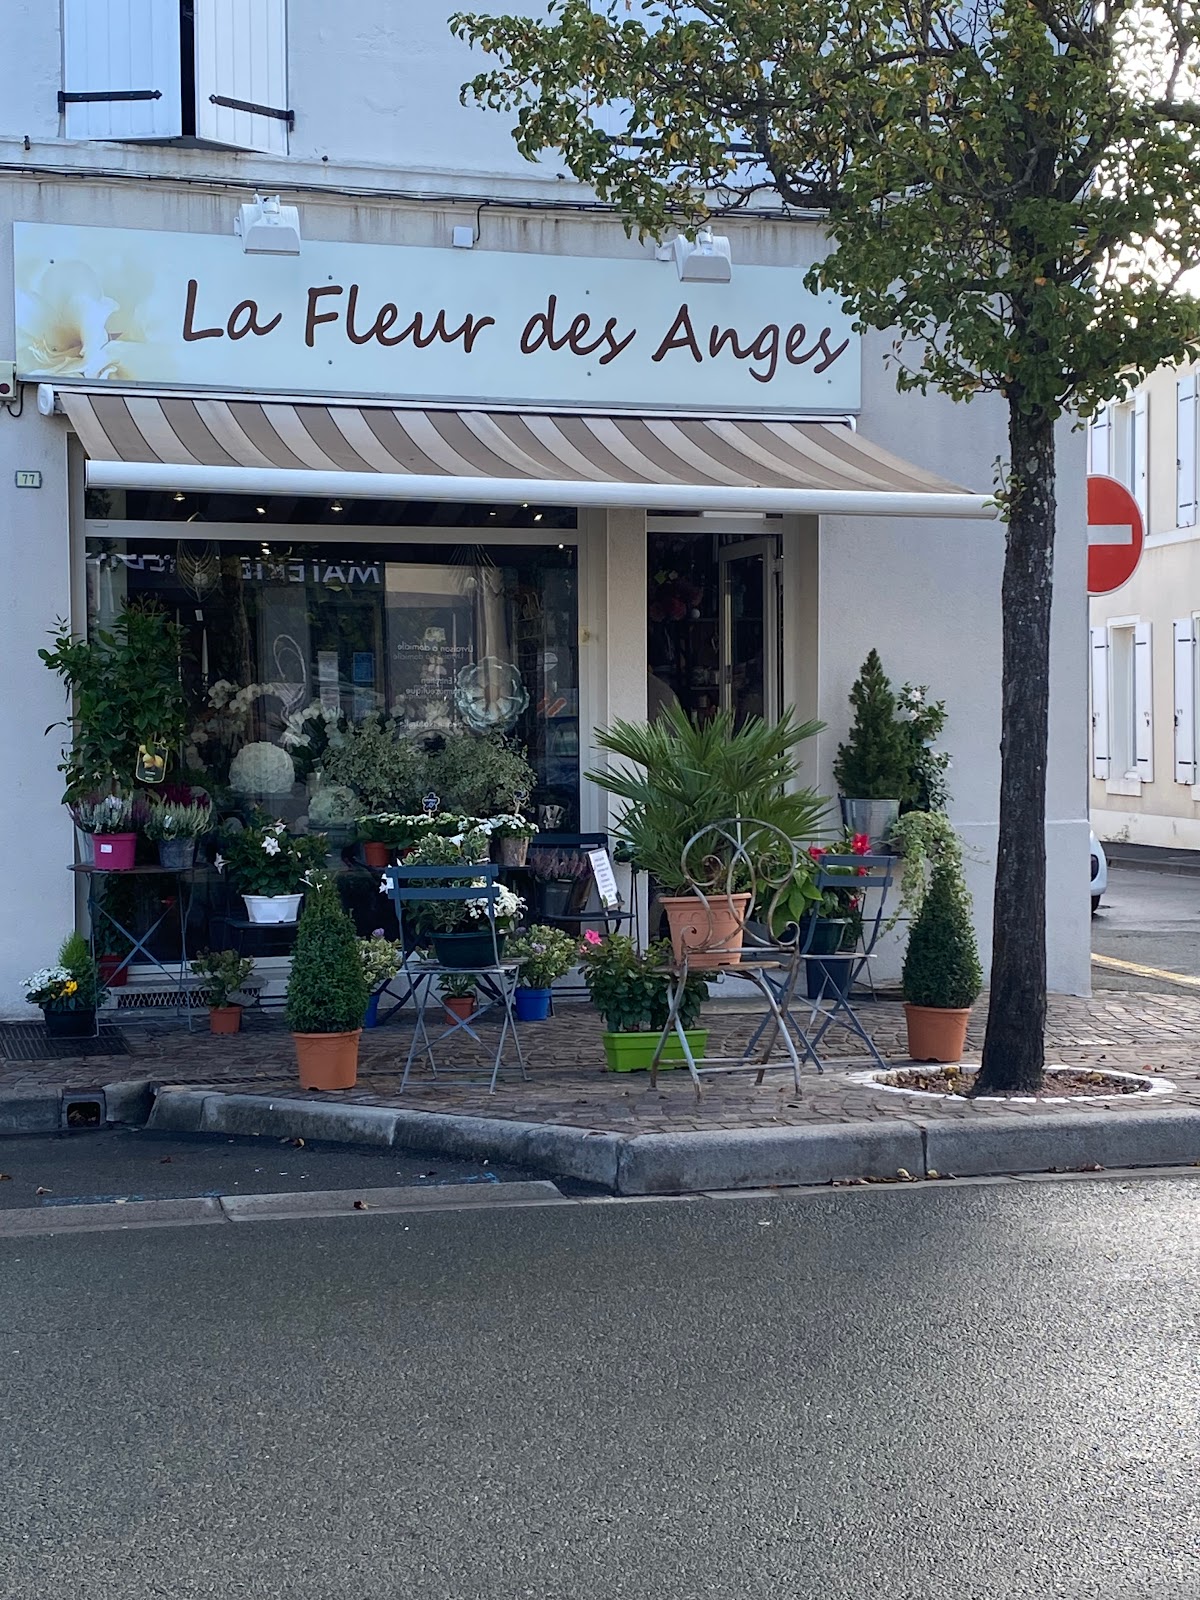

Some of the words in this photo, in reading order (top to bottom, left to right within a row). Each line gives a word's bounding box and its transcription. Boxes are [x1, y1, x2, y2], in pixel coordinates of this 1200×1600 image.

[183, 279, 282, 342] La
[304, 284, 496, 354] Fleur
[520, 294, 636, 365] des
[651, 303, 850, 383] Anges
[22, 473, 35, 485] 77
